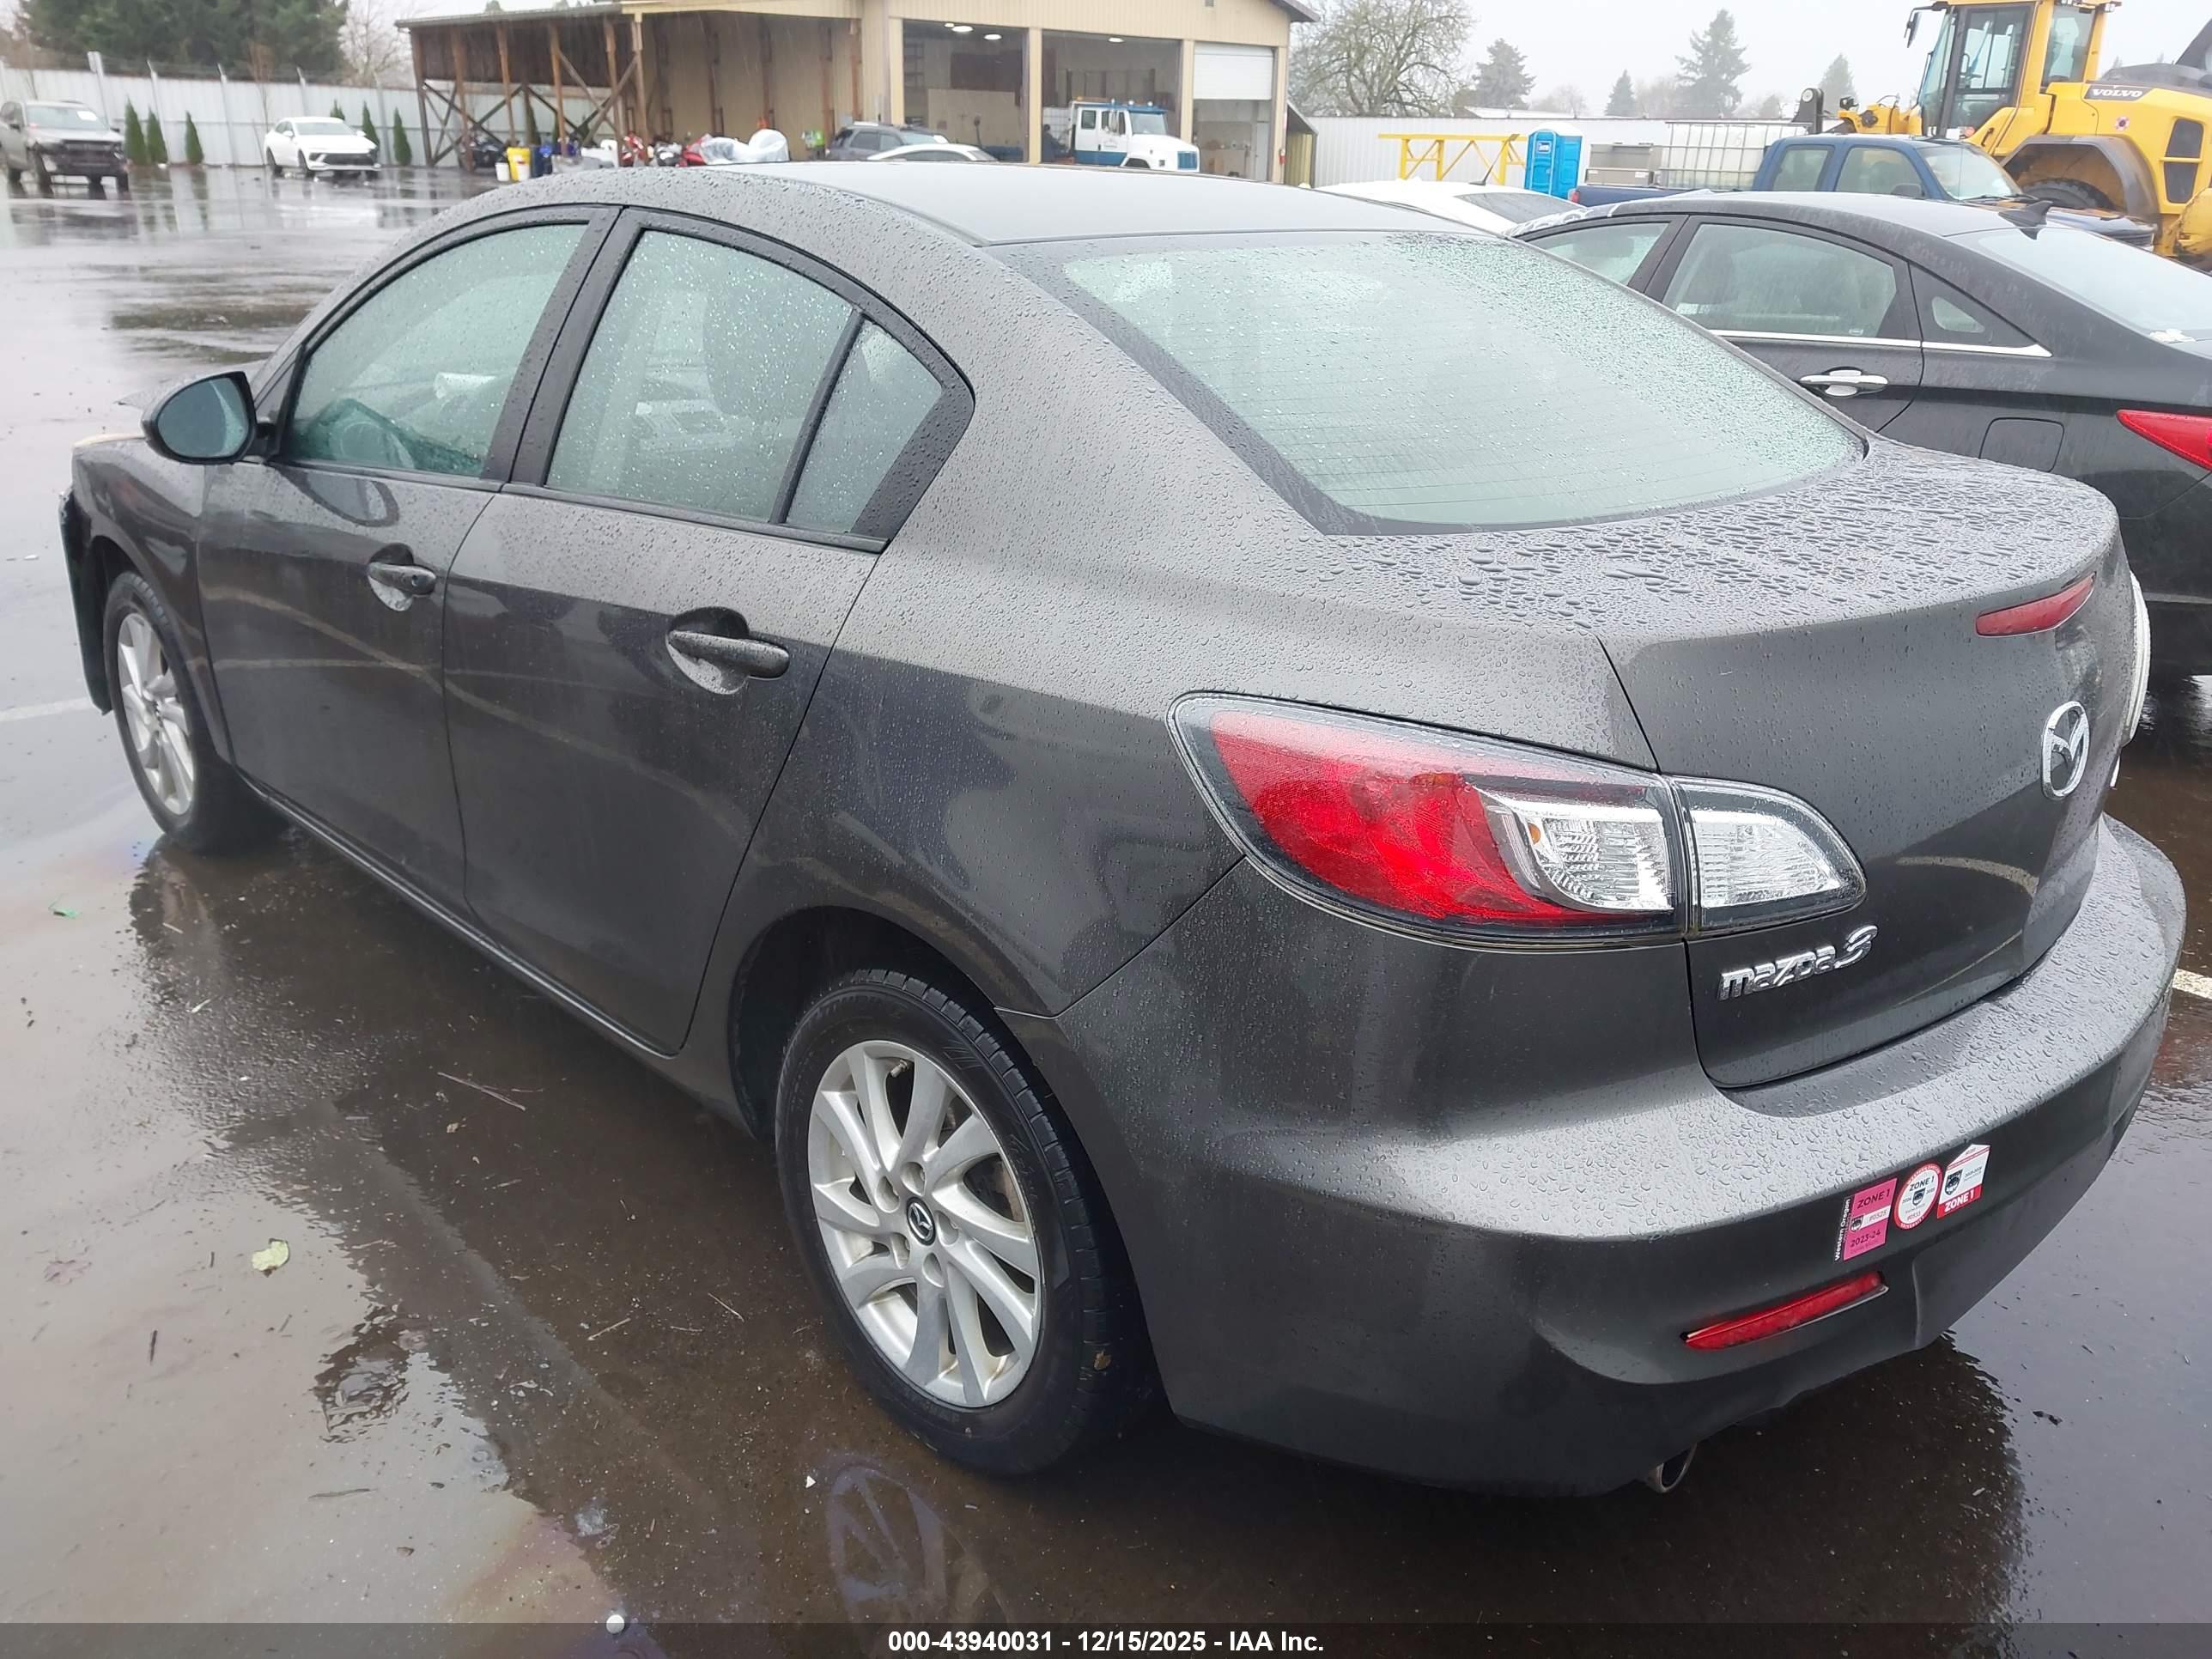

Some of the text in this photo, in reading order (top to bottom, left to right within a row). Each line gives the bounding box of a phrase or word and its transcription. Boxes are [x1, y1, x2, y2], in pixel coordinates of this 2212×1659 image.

[2092, 88, 2142, 98] VOLVO
[1909, 1177, 1931, 1192] ZONE
[1856, 1188, 1891, 1209] ZONE 1
[1943, 1191, 1970, 1213] ZONE
[1970, 1188, 1975, 1200] 1
[1834, 1227, 1844, 1261] Western
[1840, 1197, 1851, 1228] Oregon
[1850, 1229, 1881, 1248] 2023-24
